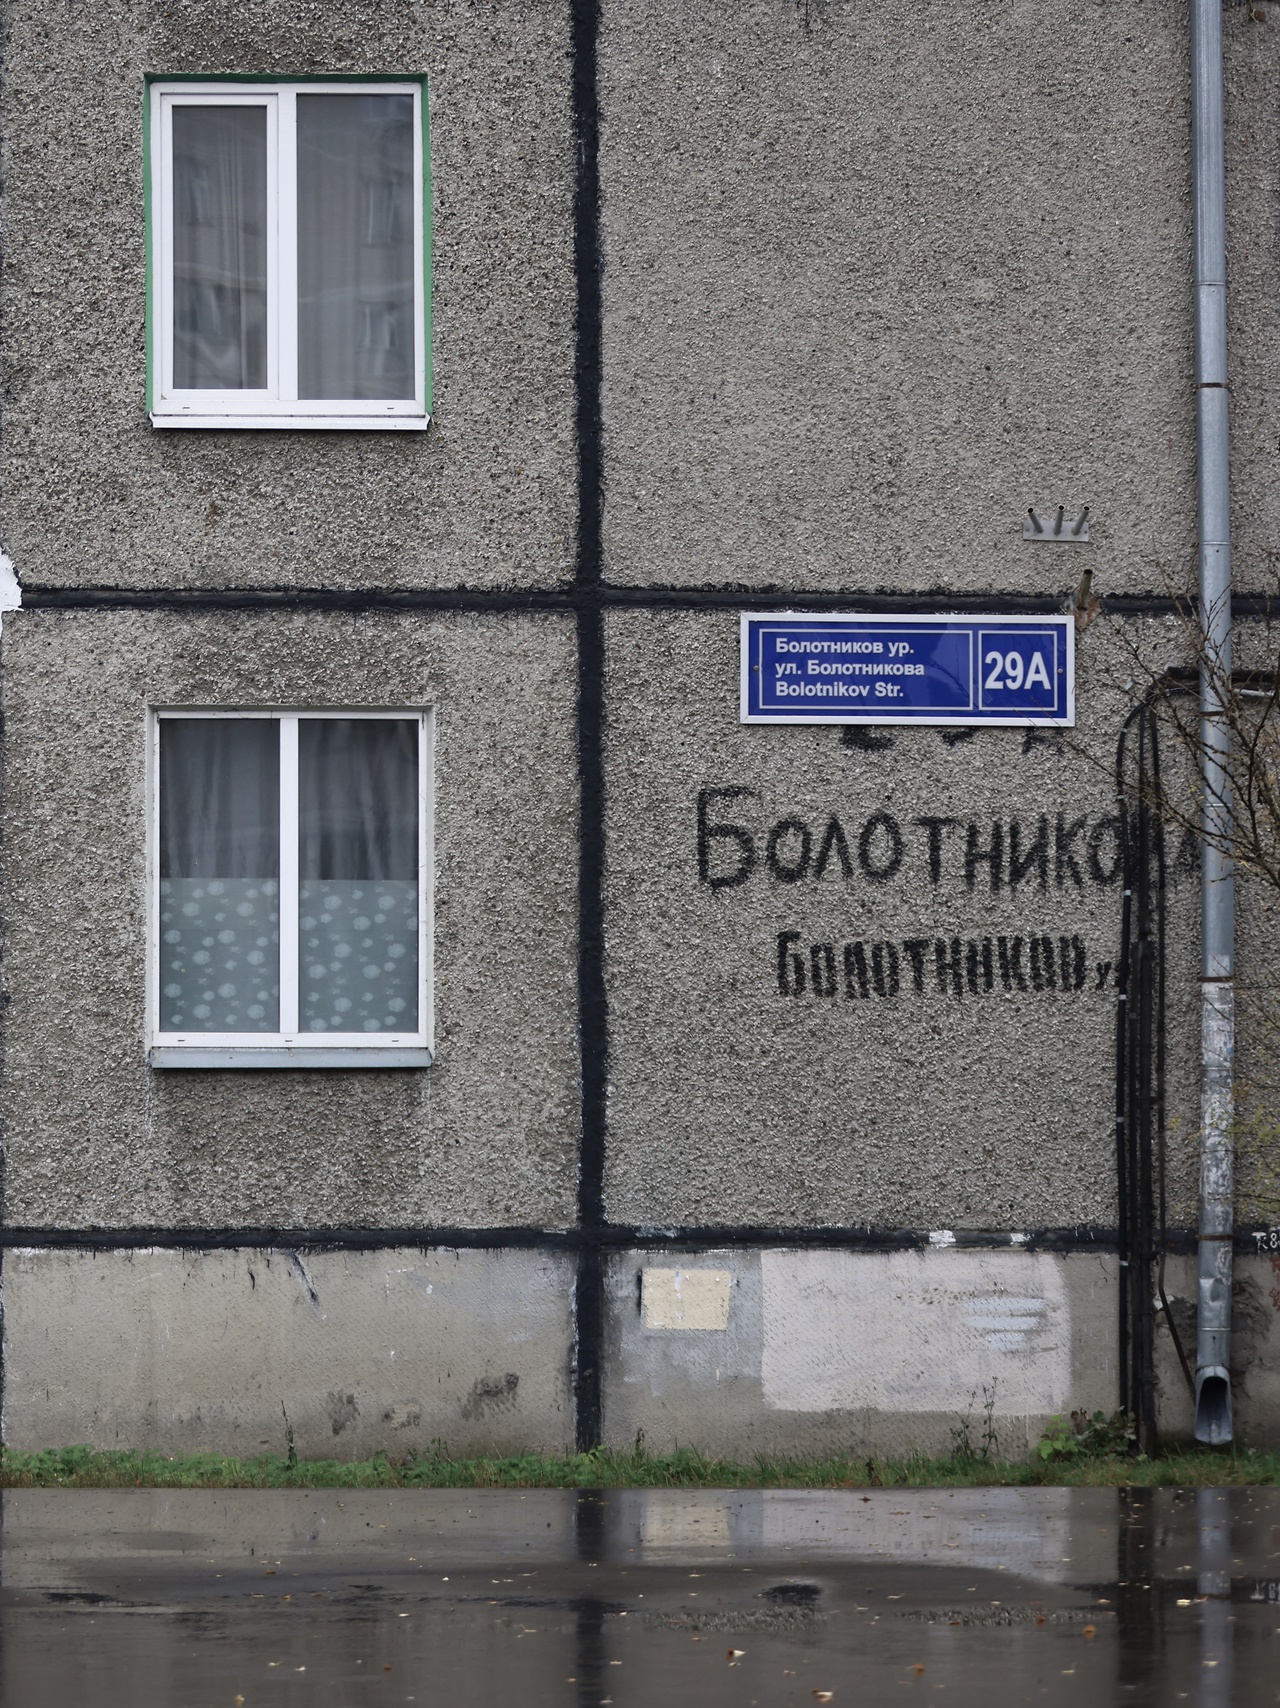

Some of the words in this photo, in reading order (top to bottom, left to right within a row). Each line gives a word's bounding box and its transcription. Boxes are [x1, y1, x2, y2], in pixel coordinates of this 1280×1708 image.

[775, 637, 884, 654] Болотников
[888, 641, 915, 657] ур.
[775, 662, 802, 678] ул.
[807, 659, 925, 676] Болотникова
[775, 681, 870, 697] Bolotnikov
[874, 681, 904, 697] Str.
